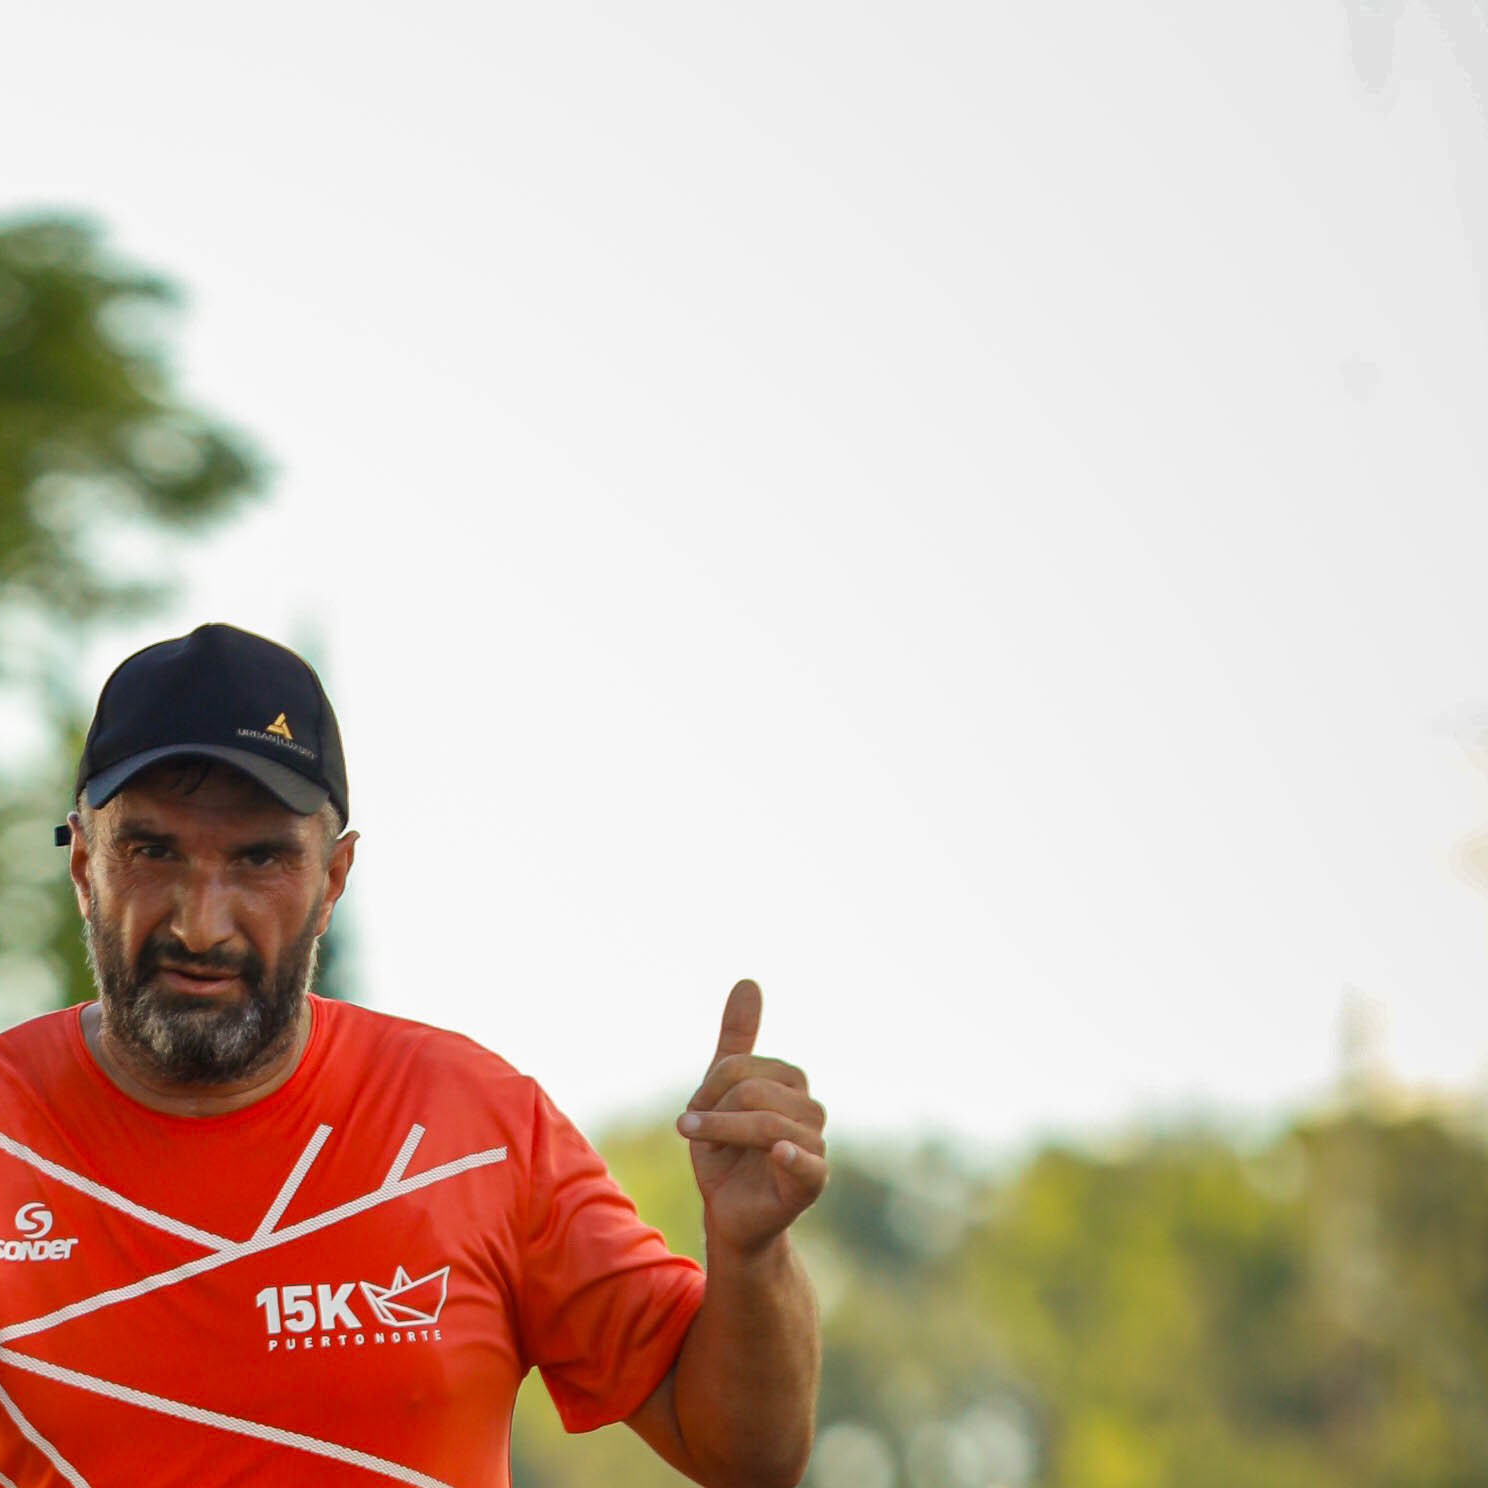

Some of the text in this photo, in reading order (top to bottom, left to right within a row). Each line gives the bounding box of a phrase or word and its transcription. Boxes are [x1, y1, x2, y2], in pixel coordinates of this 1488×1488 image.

[256, 1282, 362, 1335] 15K
[268, 1330, 442, 1352] PUERTO NORTE
